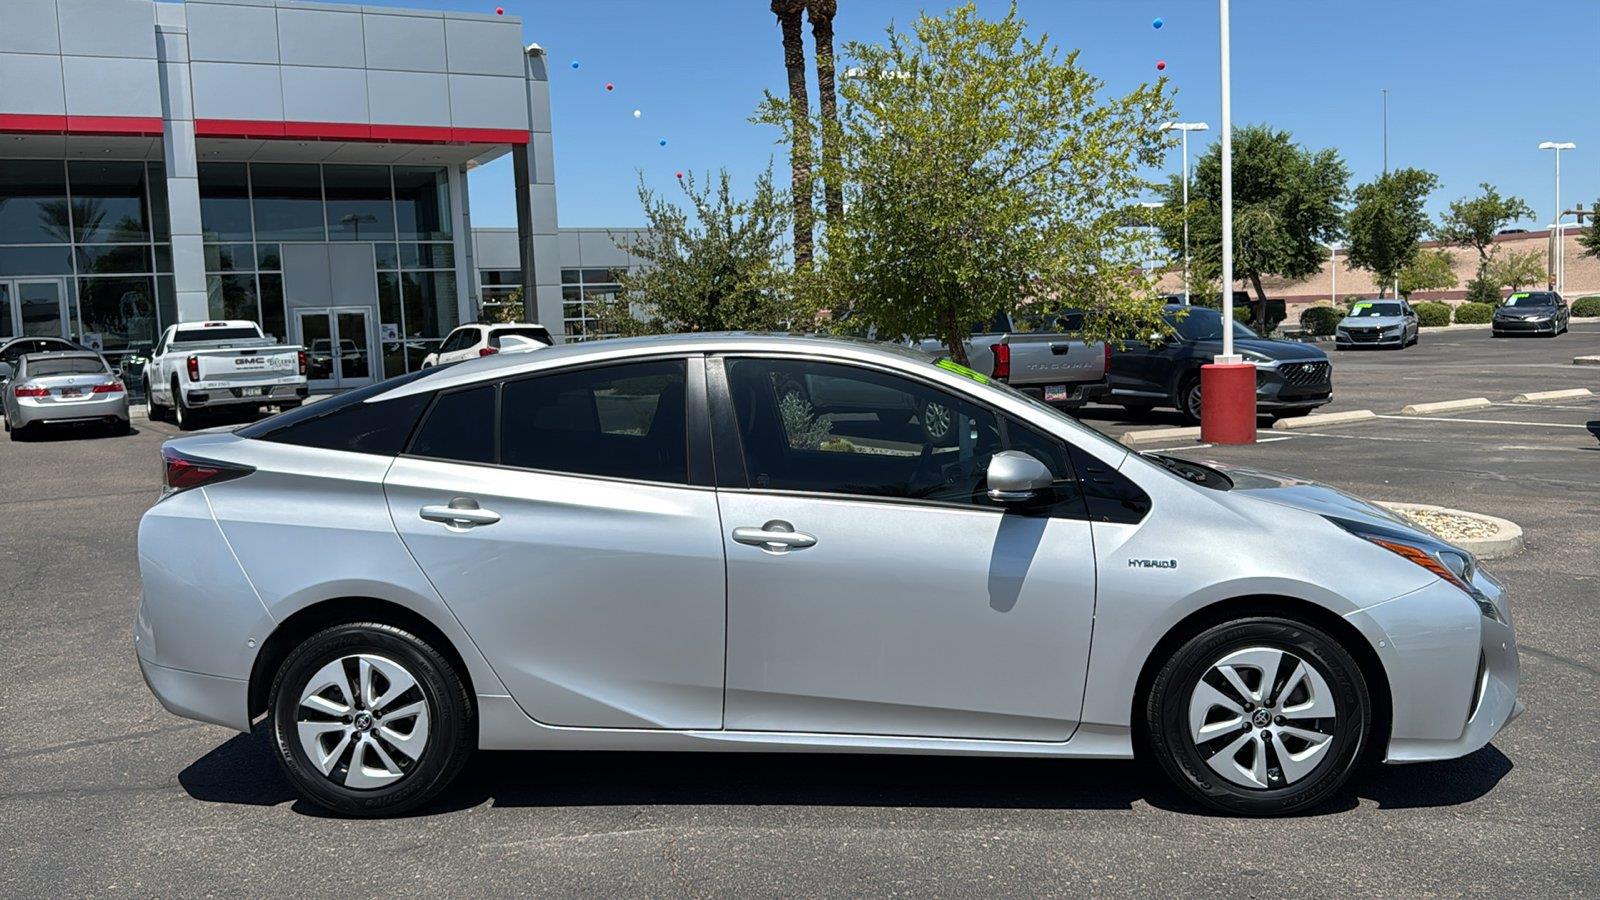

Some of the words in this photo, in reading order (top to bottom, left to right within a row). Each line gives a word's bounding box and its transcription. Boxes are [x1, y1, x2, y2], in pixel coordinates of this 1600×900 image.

[235, 357, 265, 365] GMC
[1026, 361, 1094, 370] TACOMA
[1128, 559, 1169, 568] HYBRID
